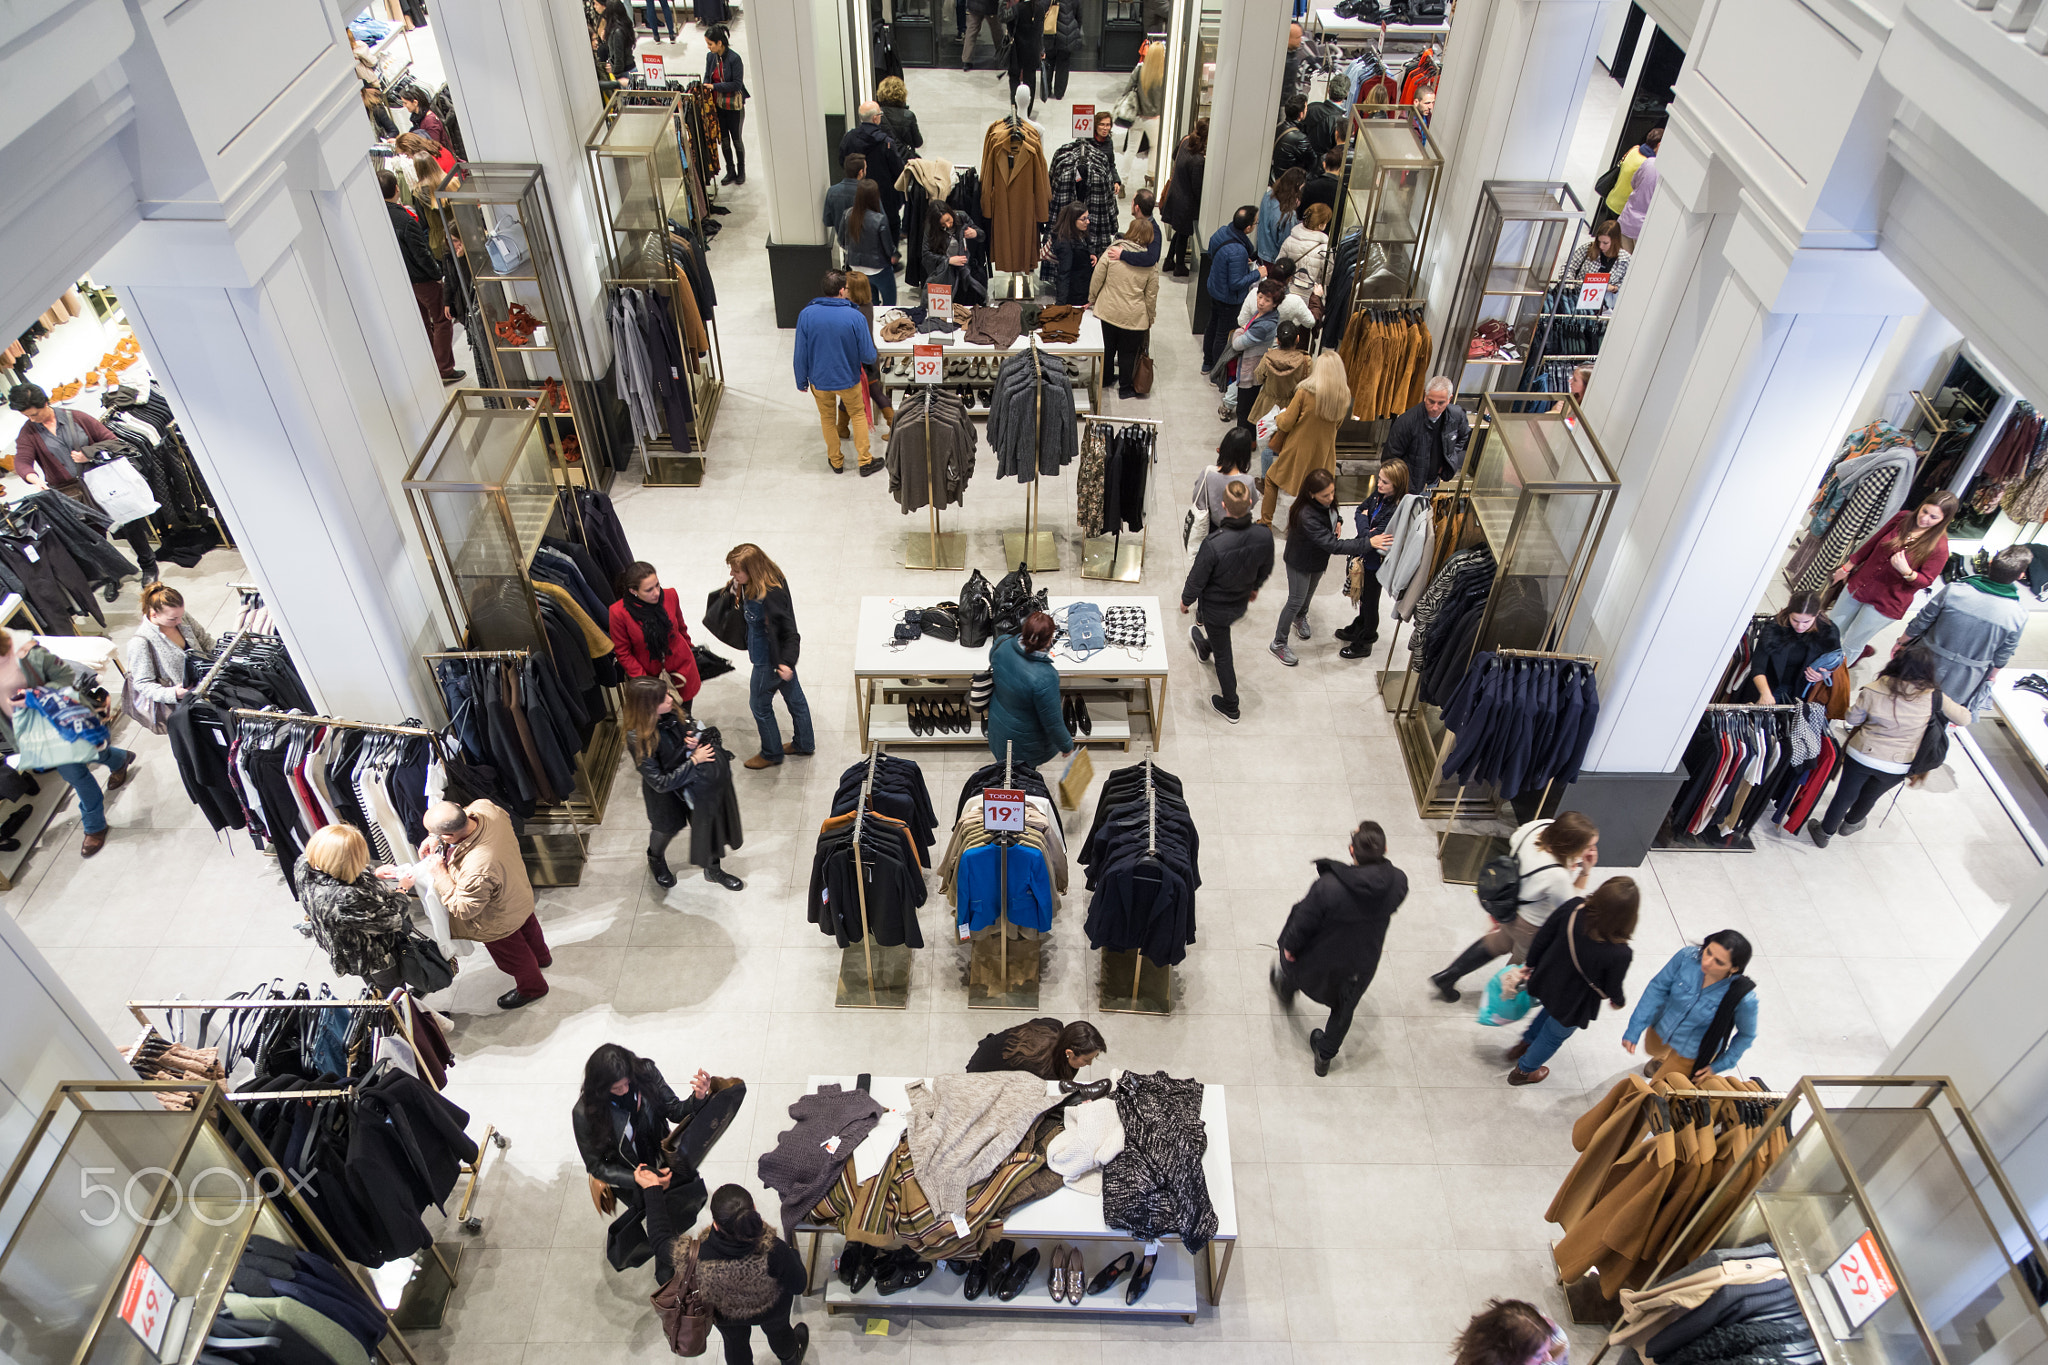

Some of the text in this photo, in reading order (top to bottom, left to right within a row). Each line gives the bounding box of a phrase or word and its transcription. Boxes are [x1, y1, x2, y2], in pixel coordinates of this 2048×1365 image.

[646, 68, 658, 79] 19
[1075, 119, 1089, 130] 49
[1583, 288, 1598, 302] 19
[931, 298, 945, 310] 12
[917, 361, 935, 375] 39
[988, 806, 1012, 821] 19
[1840, 1254, 1869, 1295] 29
[142, 1289, 159, 1338] 49
